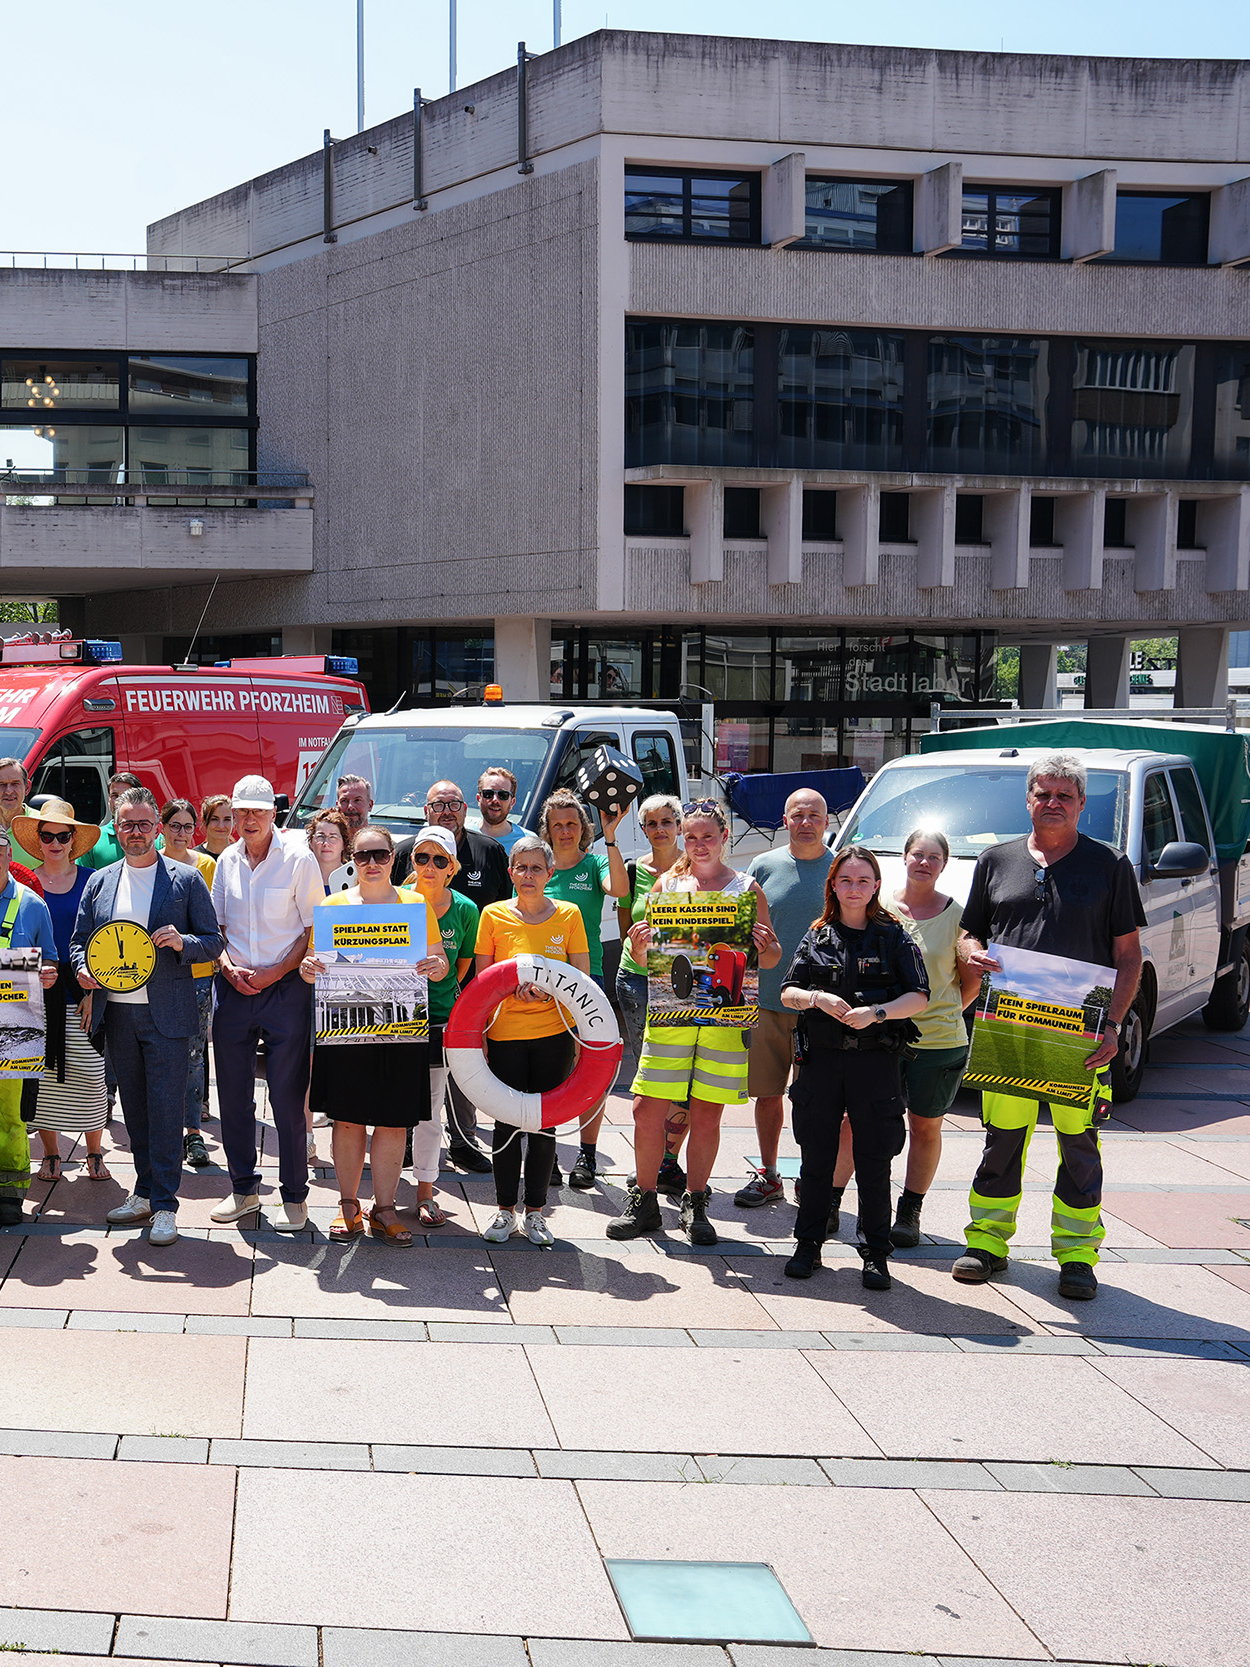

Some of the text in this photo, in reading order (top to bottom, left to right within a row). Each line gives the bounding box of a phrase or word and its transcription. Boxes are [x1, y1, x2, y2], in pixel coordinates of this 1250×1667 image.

[817, 641, 886, 652] Hier forscht
[125, 690, 330, 714] FEUERWEHR PFORZHEIM
[298, 738, 332, 748] IM NOTFA
[675, 917, 733, 925] KINDERSPIEL.
[334, 925, 380, 933] SPIELPLAN
[334, 937, 409, 946] KÜRZUNGSPLAN.
[532, 966, 604, 1028] TITANIC
[1000, 997, 1082, 1020] KEIN SPIELRAUM
[997, 1010, 1082, 1033] FÜR KOMMUNEN.
